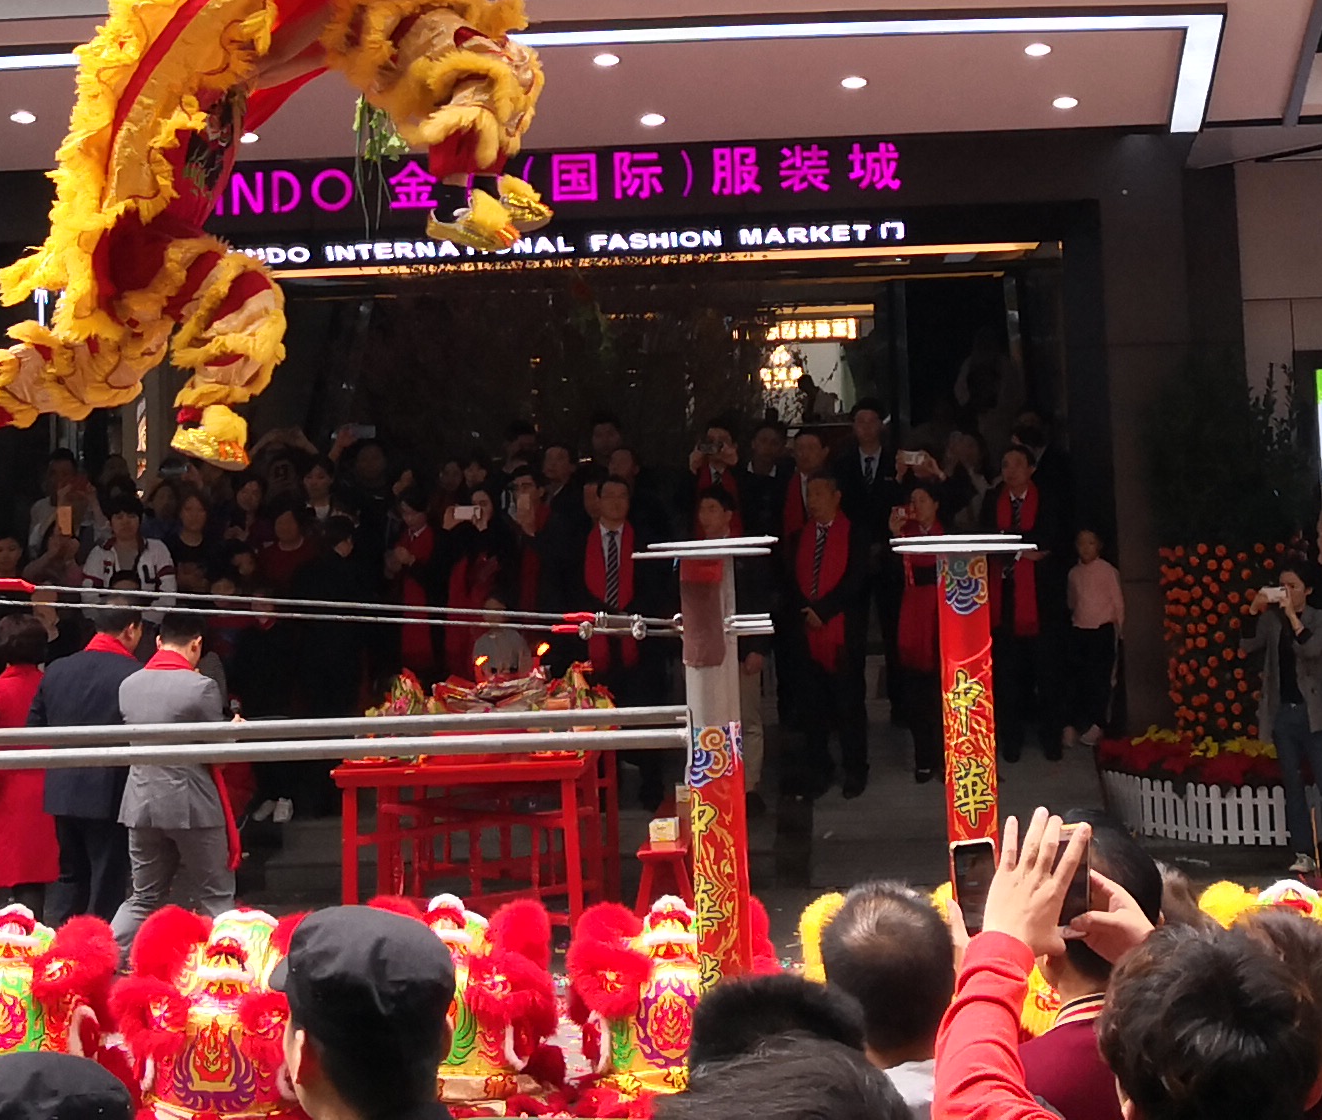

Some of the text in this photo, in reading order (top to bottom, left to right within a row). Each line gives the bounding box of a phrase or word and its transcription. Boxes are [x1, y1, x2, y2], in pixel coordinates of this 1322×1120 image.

[214, 168, 355, 216] NDO
[326, 236, 575, 262] INTERNANAL
[590, 229, 723, 252] FASHION
[739, 224, 872, 245] MARKET
